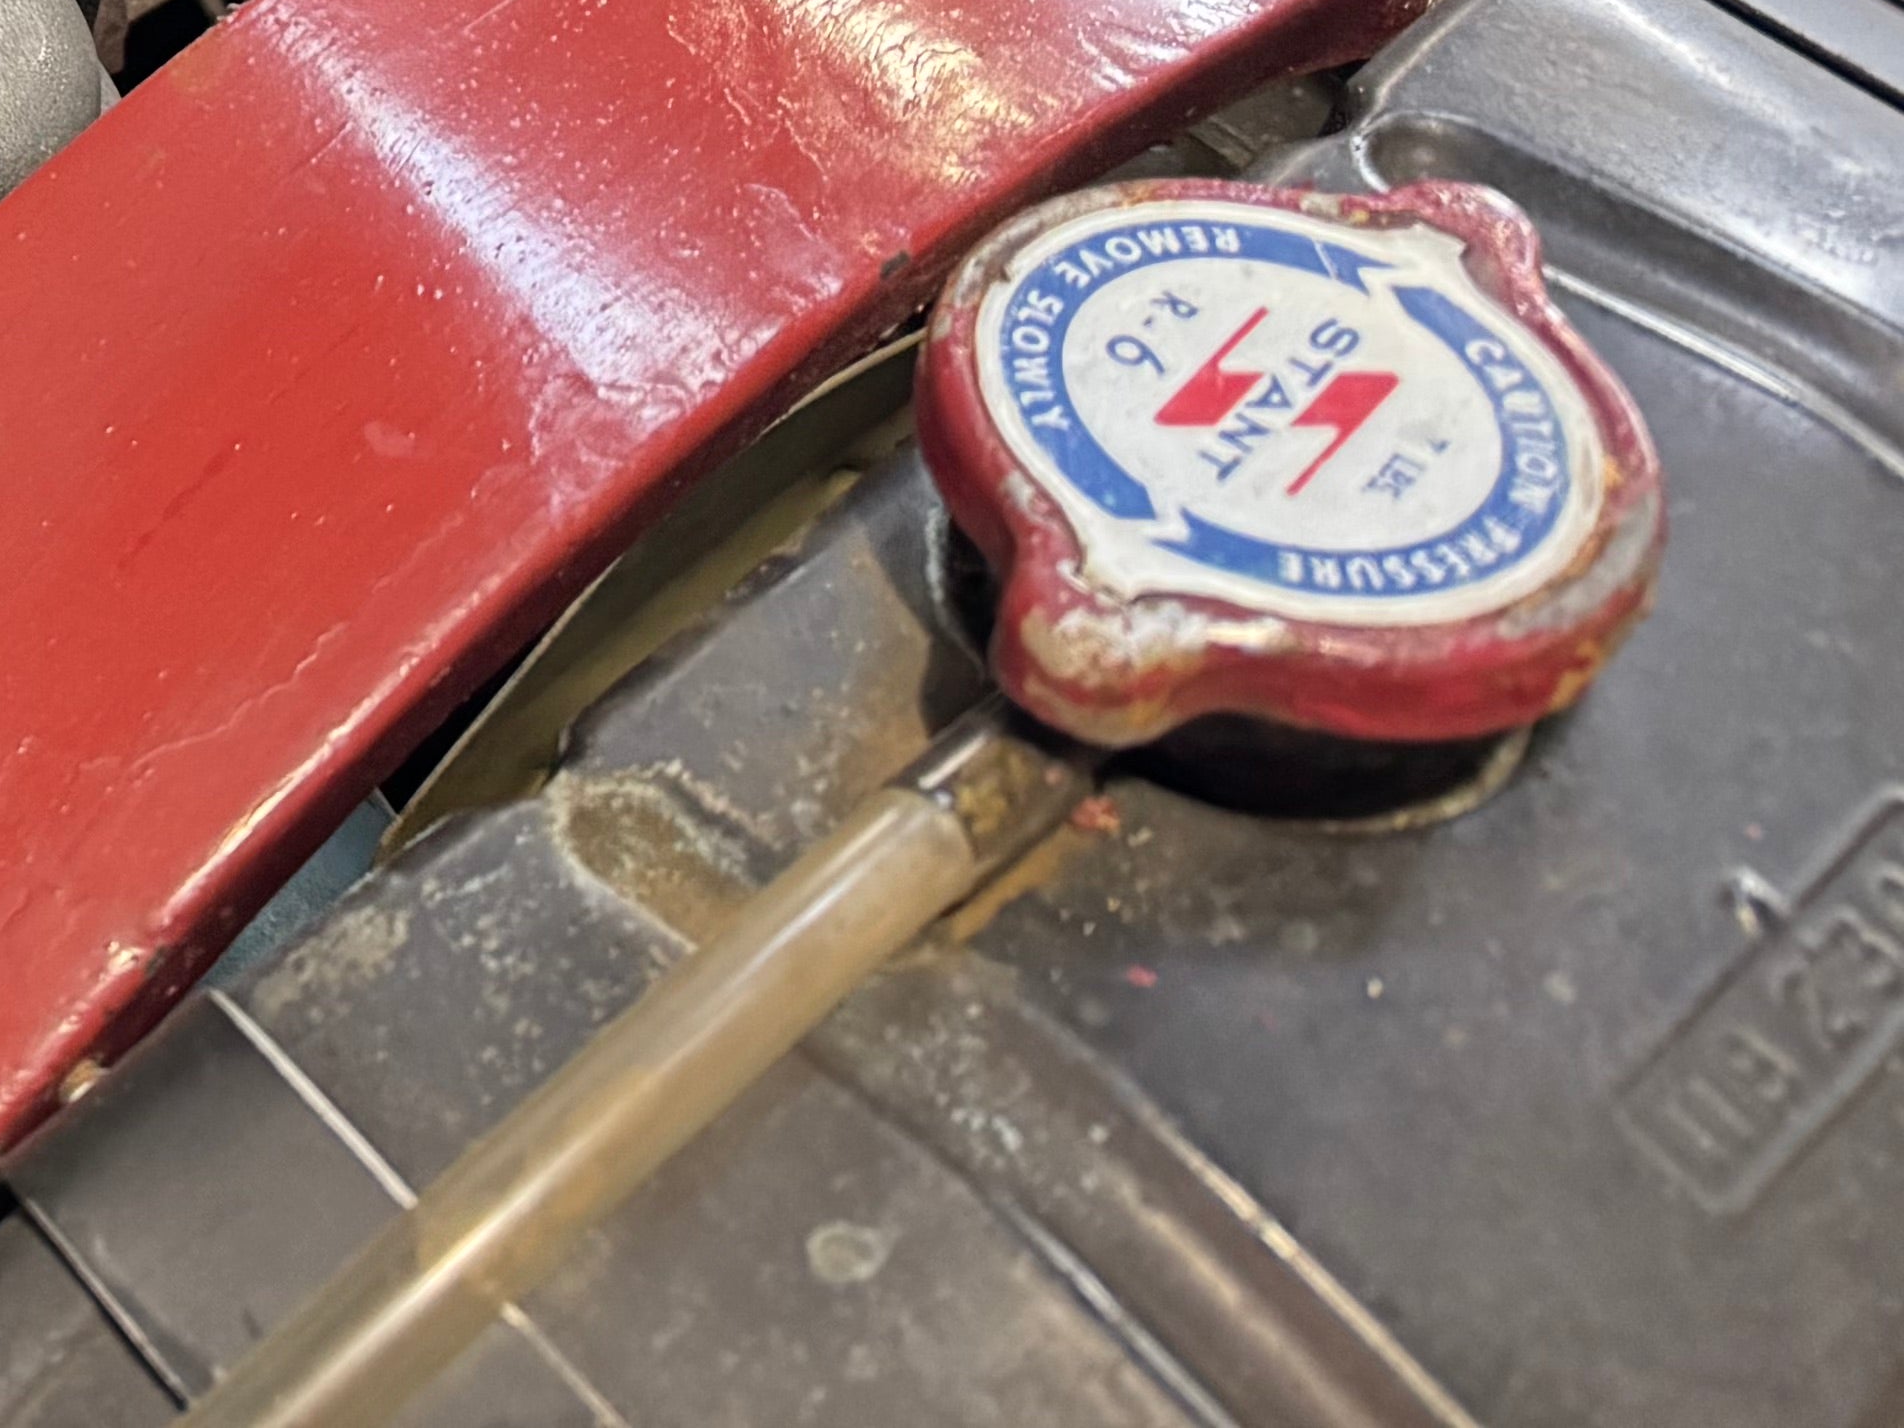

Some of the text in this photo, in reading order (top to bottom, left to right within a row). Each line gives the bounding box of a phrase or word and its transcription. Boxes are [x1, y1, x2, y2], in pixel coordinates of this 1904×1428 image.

[1011, 225, 1242, 432] REMOVE SLOWLY
[1197, 316, 1361, 481] STANT
[1277, 338, 1559, 591] CAUTION PRESSURE
